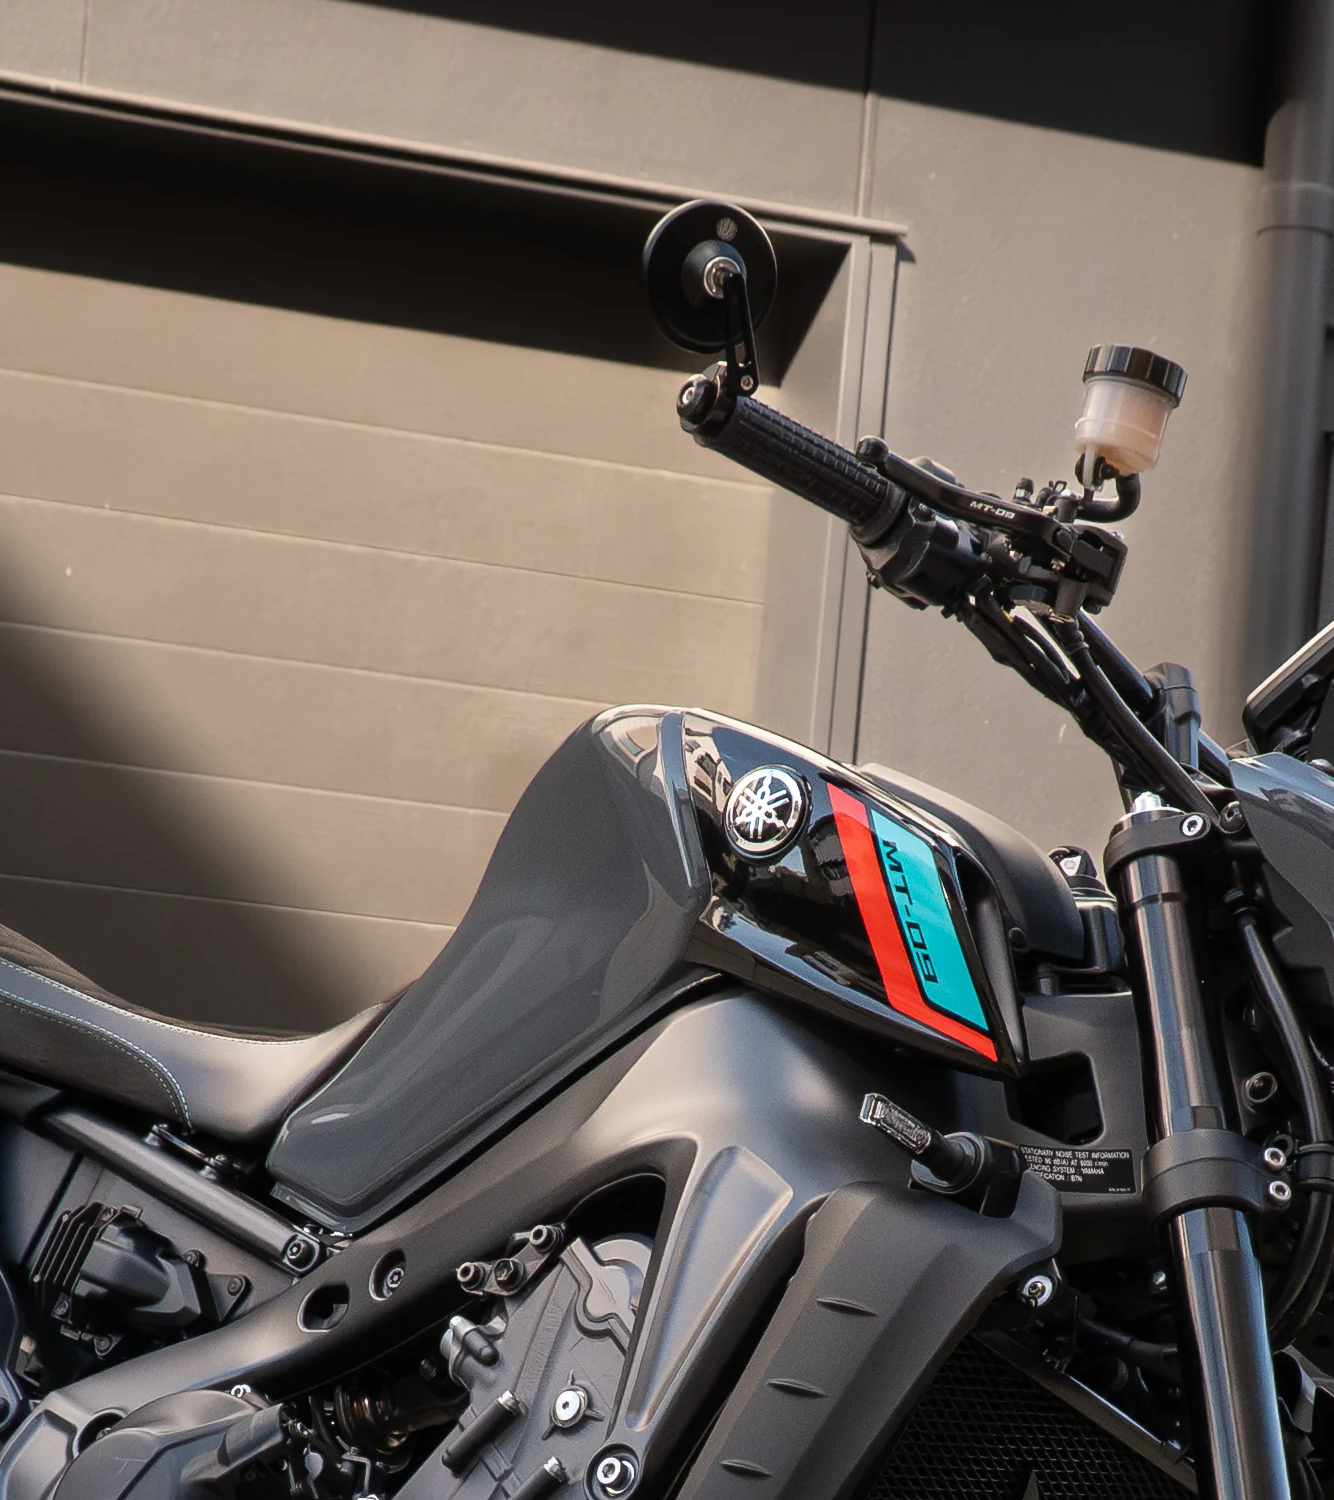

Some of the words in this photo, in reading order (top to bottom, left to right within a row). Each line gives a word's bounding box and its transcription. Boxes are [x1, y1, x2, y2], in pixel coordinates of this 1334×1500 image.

[969, 500, 1016, 520] MT-09
[881, 839, 939, 984] MT-09
[1021, 1146, 1053, 1157] STATIONARY
[1055, 1150, 1073, 1158] NOISE
[1074, 1151, 1089, 1159] TEST
[1091, 1151, 1130, 1159] INFORMATION
[1052, 1165, 1075, 1174] SYSTEM
